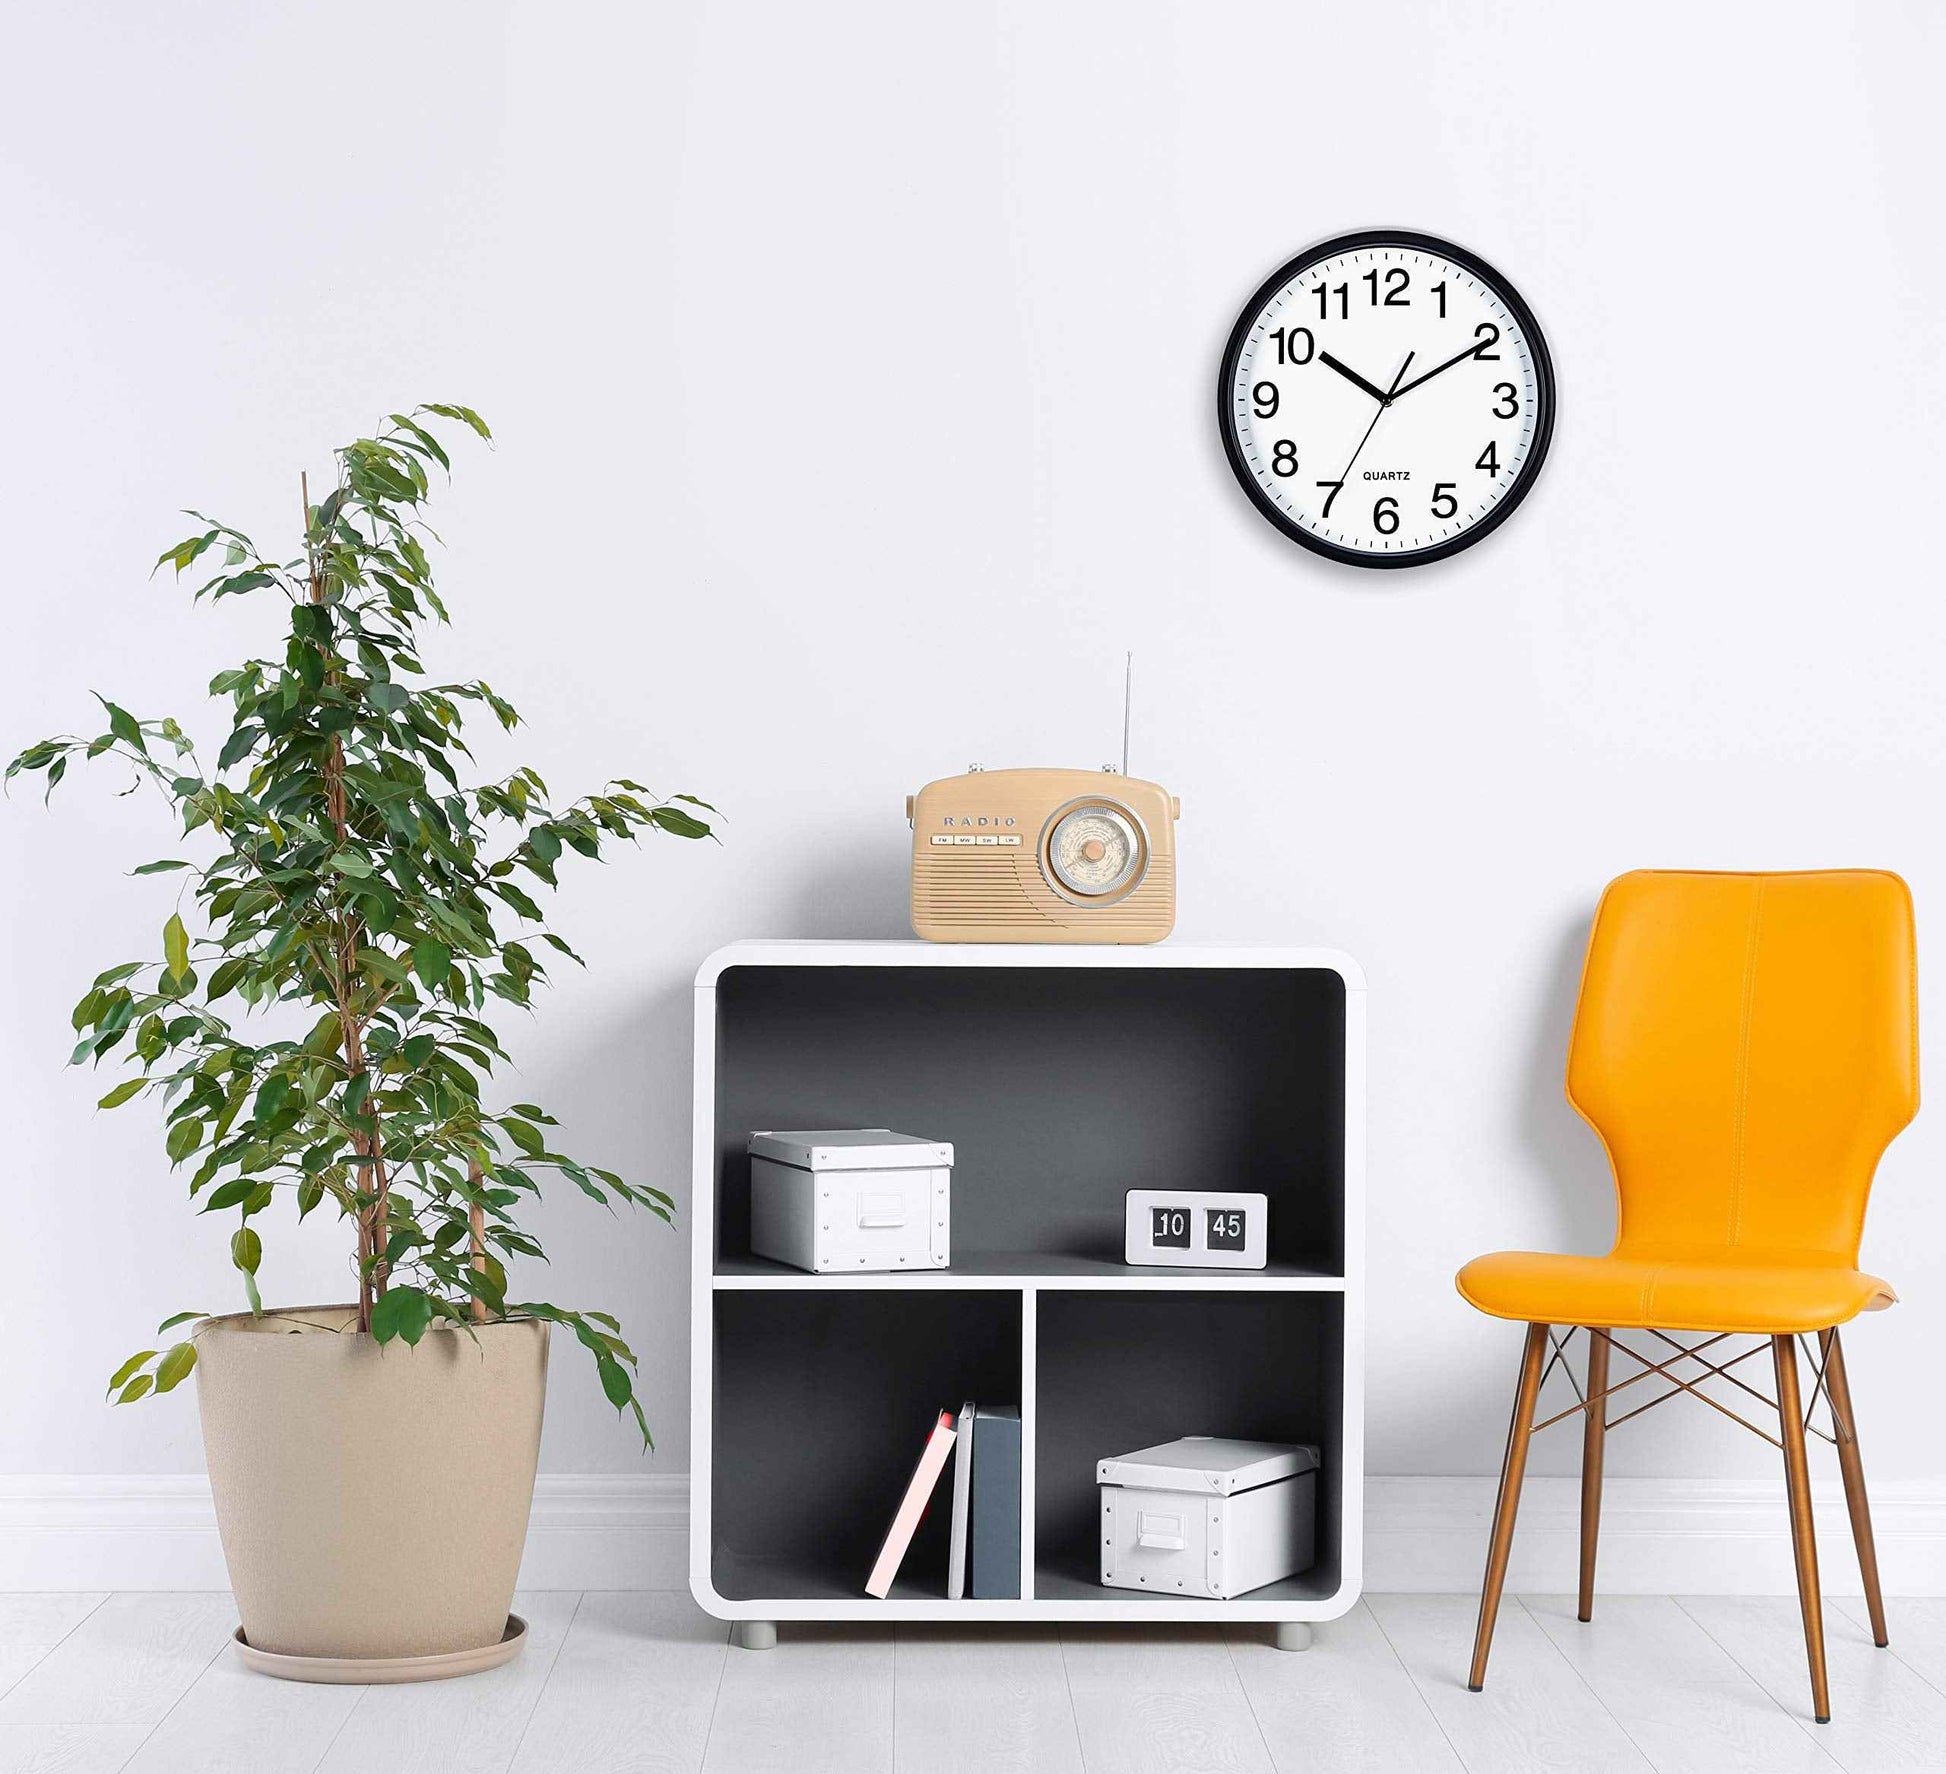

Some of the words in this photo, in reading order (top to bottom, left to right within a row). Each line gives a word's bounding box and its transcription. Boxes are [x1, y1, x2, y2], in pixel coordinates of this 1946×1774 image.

[1311, 282, 1348, 320] 11
[1363, 268, 1410, 306] 12
[1430, 281, 1446, 318] 1
[1269, 327, 1314, 365] 10
[1473, 323, 1500, 361] 2
[1252, 381, 1279, 419] 9
[1492, 382, 1519, 419] 3
[1271, 439, 1299, 477] 8
[1363, 471, 1411, 481] QUARTZ
[1475, 441, 1500, 478] 4
[1316, 481, 1344, 518] 7
[1373, 497, 1400, 534] 6
[1430, 483, 1458, 519] 5
[943, 816, 1016, 826] RADIO
[1212, 1214, 1241, 1237] 45
